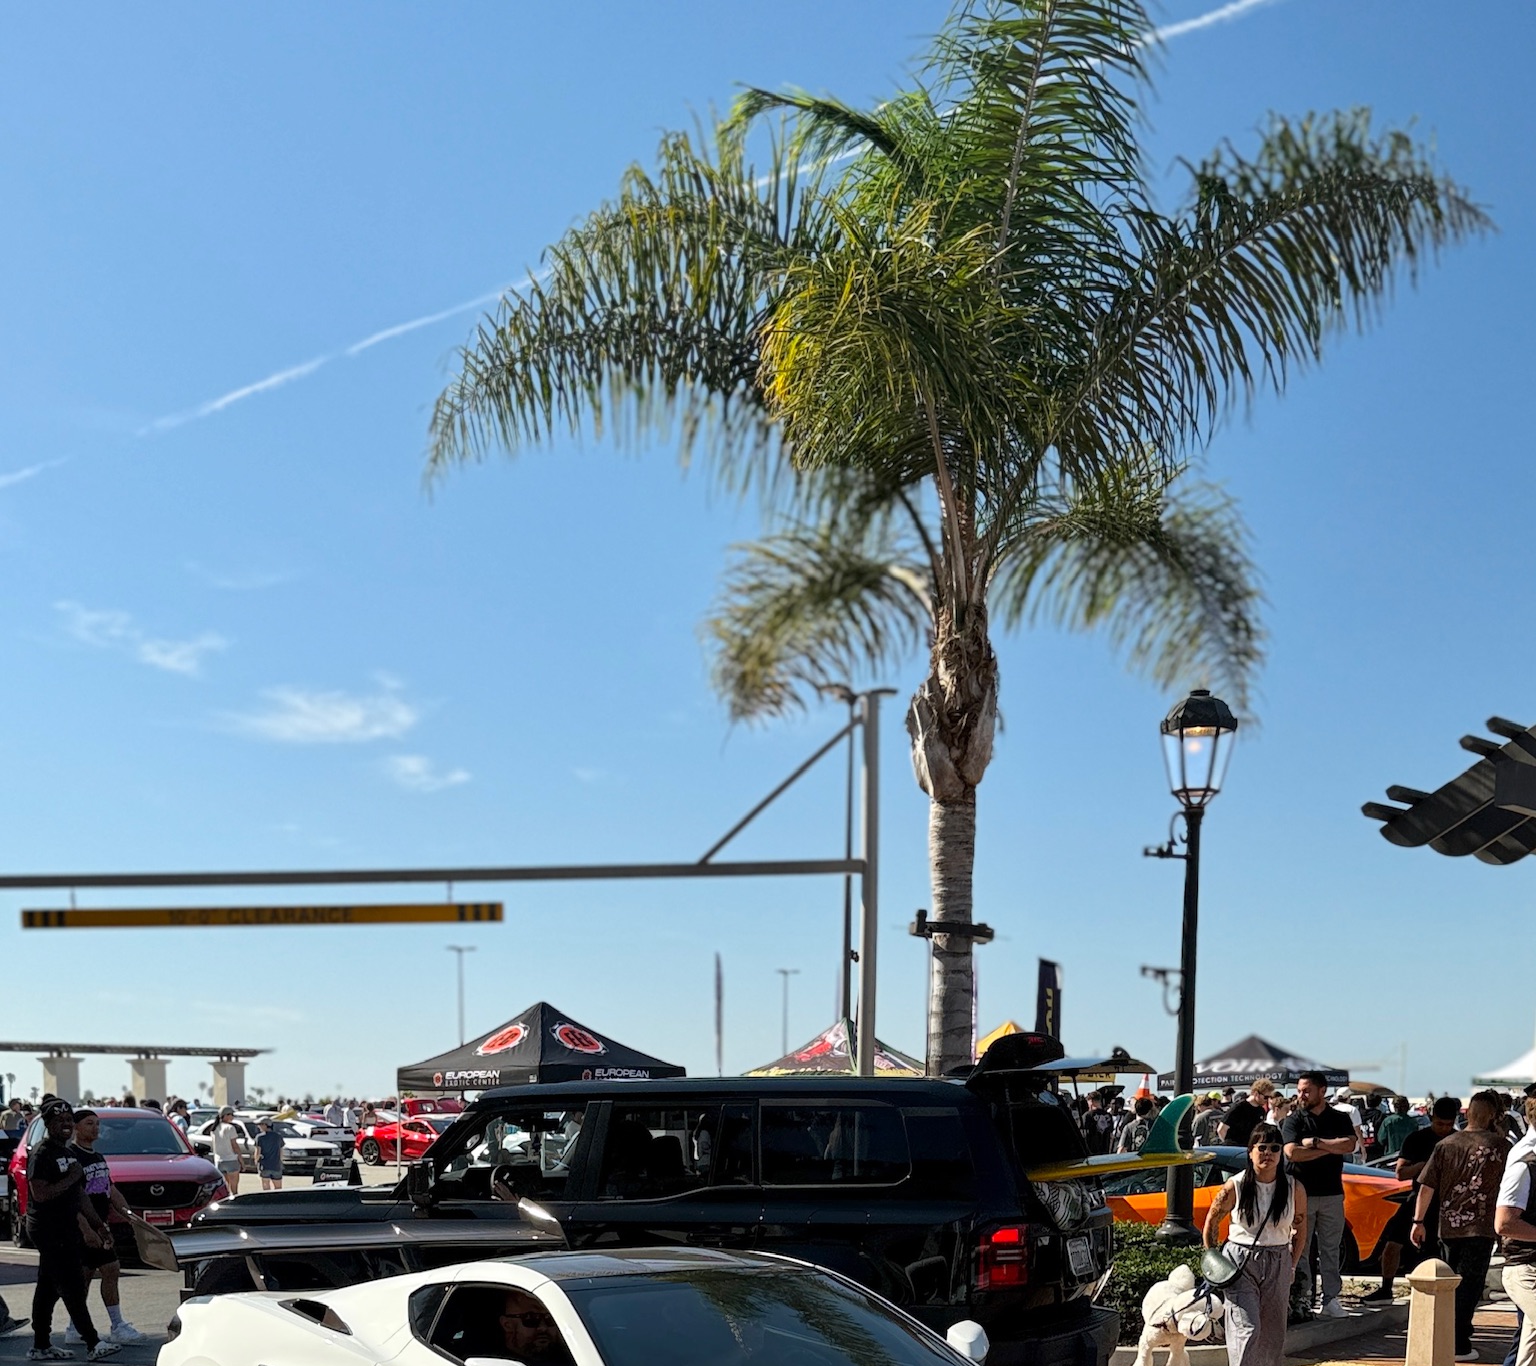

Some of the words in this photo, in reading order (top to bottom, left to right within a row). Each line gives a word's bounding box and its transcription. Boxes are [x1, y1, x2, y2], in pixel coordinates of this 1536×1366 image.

[226, 908, 353, 923] CLEARANCE
[445, 1070, 500, 1080] EUROPEAN
[595, 1068, 650, 1079] EUROPEAN
[1192, 1076, 1228, 1085] OTECTION
[1230, 1073, 1283, 1083] TECHNOLOGY
[473, 1078, 500, 1087] CENTER
